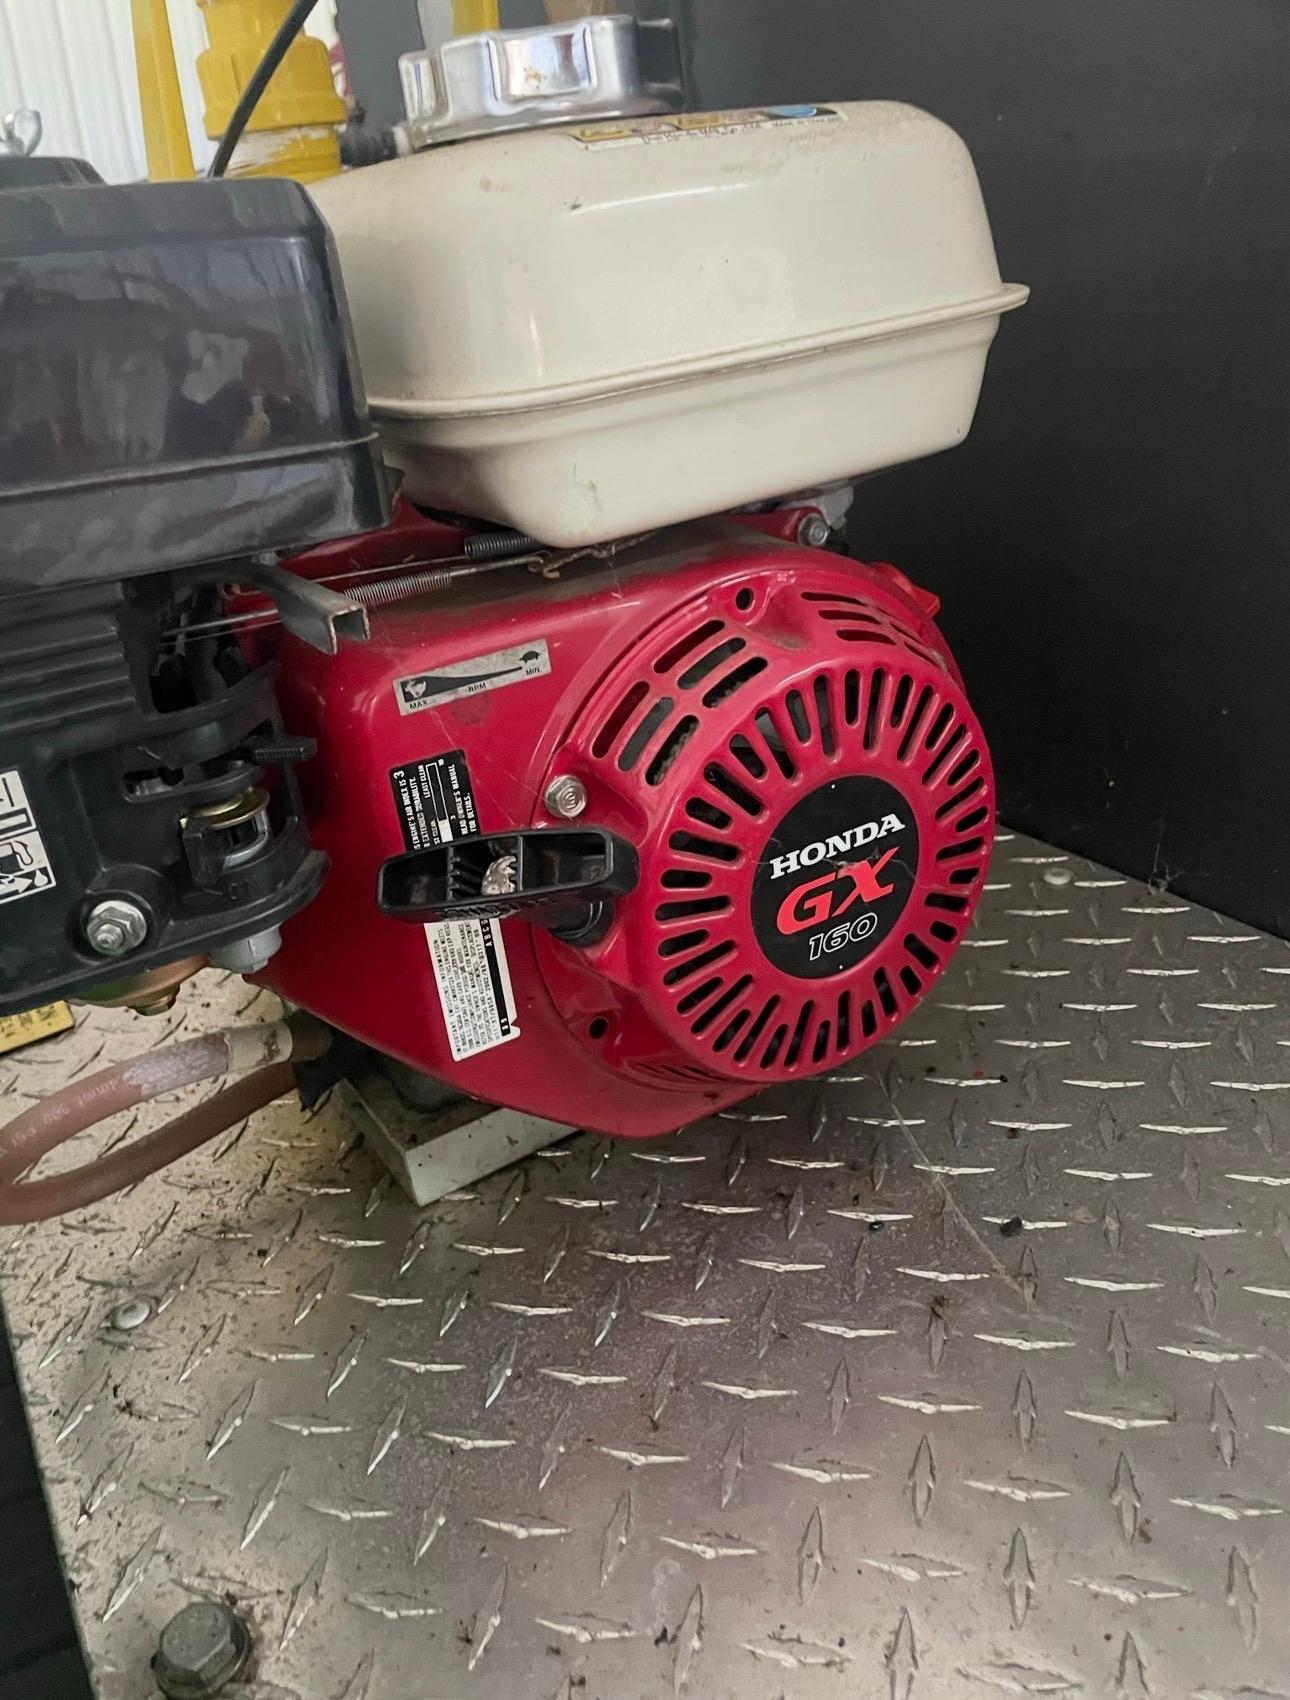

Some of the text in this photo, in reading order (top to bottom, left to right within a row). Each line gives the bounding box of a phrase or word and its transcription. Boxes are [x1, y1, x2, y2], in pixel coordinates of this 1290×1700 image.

[468, 682, 487, 693] RPM
[393, 770, 404, 779] 3
[418, 765, 430, 798] LEAST CLEAN
[401, 787, 411, 805] INDEX
[409, 777, 422, 812] DURABILITY.
[448, 764, 468, 835] READ OWNER'S MANUAL
[464, 793, 474, 818] DETAILS.
[405, 806, 413, 816] AIR
[407, 816, 419, 844] ENGINE'S
[417, 812, 429, 842] EXTENDED
[769, 813, 906, 879] HONDA
[776, 847, 900, 935] GX
[809, 912, 878, 961] 160
[433, 940, 445, 979] INFORMATION
[443, 986, 454, 1017] EMISSIONS
[450, 1022, 461, 1052] IMPORTANT
